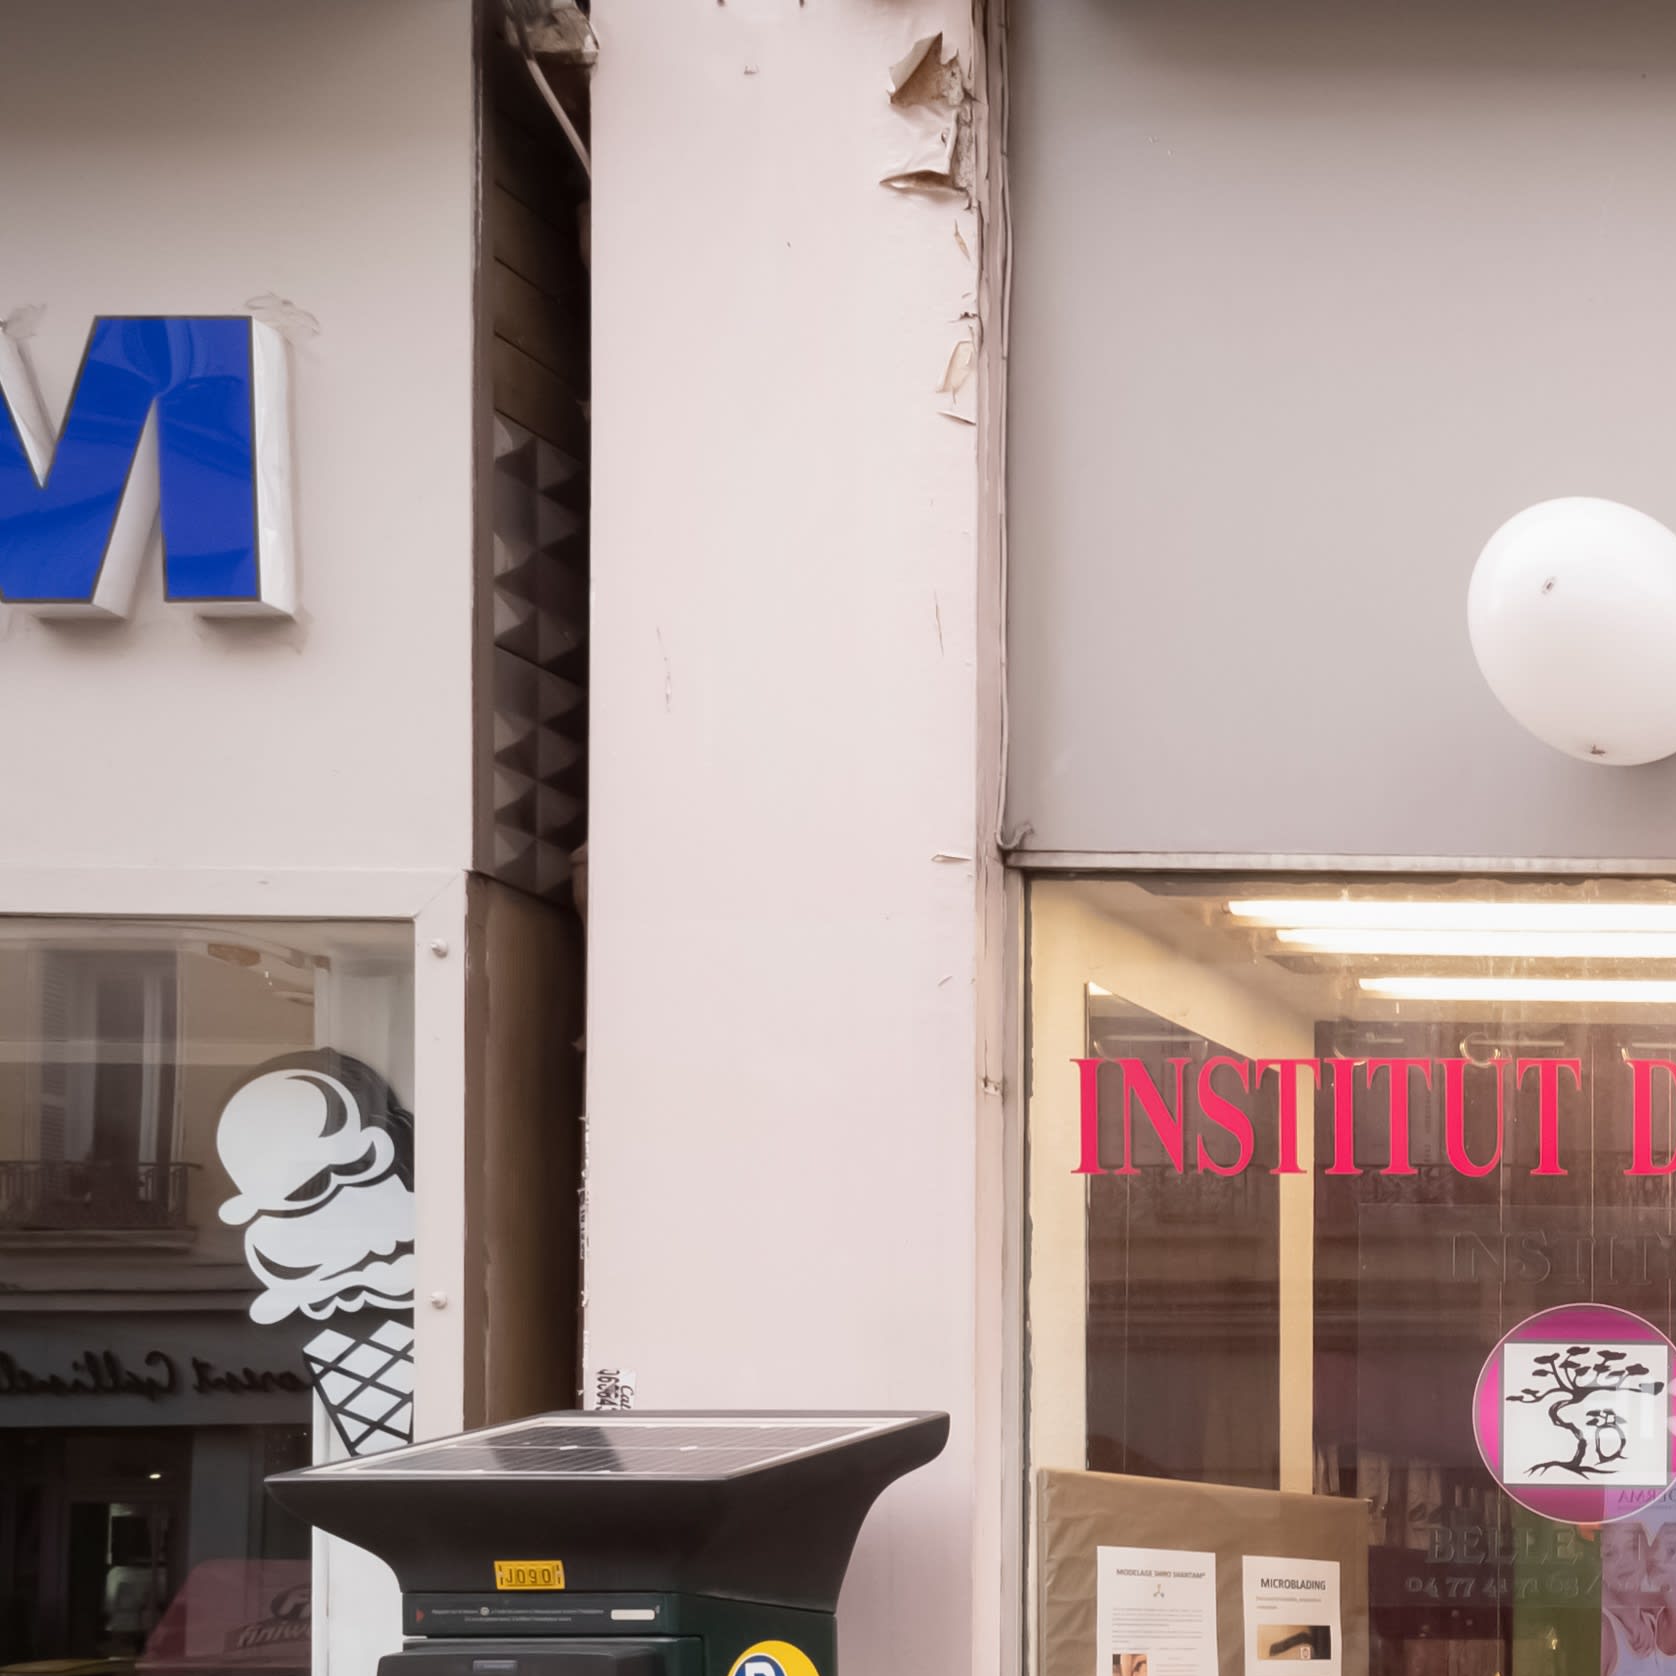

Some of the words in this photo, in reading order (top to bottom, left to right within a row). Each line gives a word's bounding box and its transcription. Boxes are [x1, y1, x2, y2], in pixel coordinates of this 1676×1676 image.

[1070, 1056, 1582, 1176] INSTITUT
[504, 1568, 552, 1585] J090
[1260, 1577, 1326, 1591] MICROBLADING
